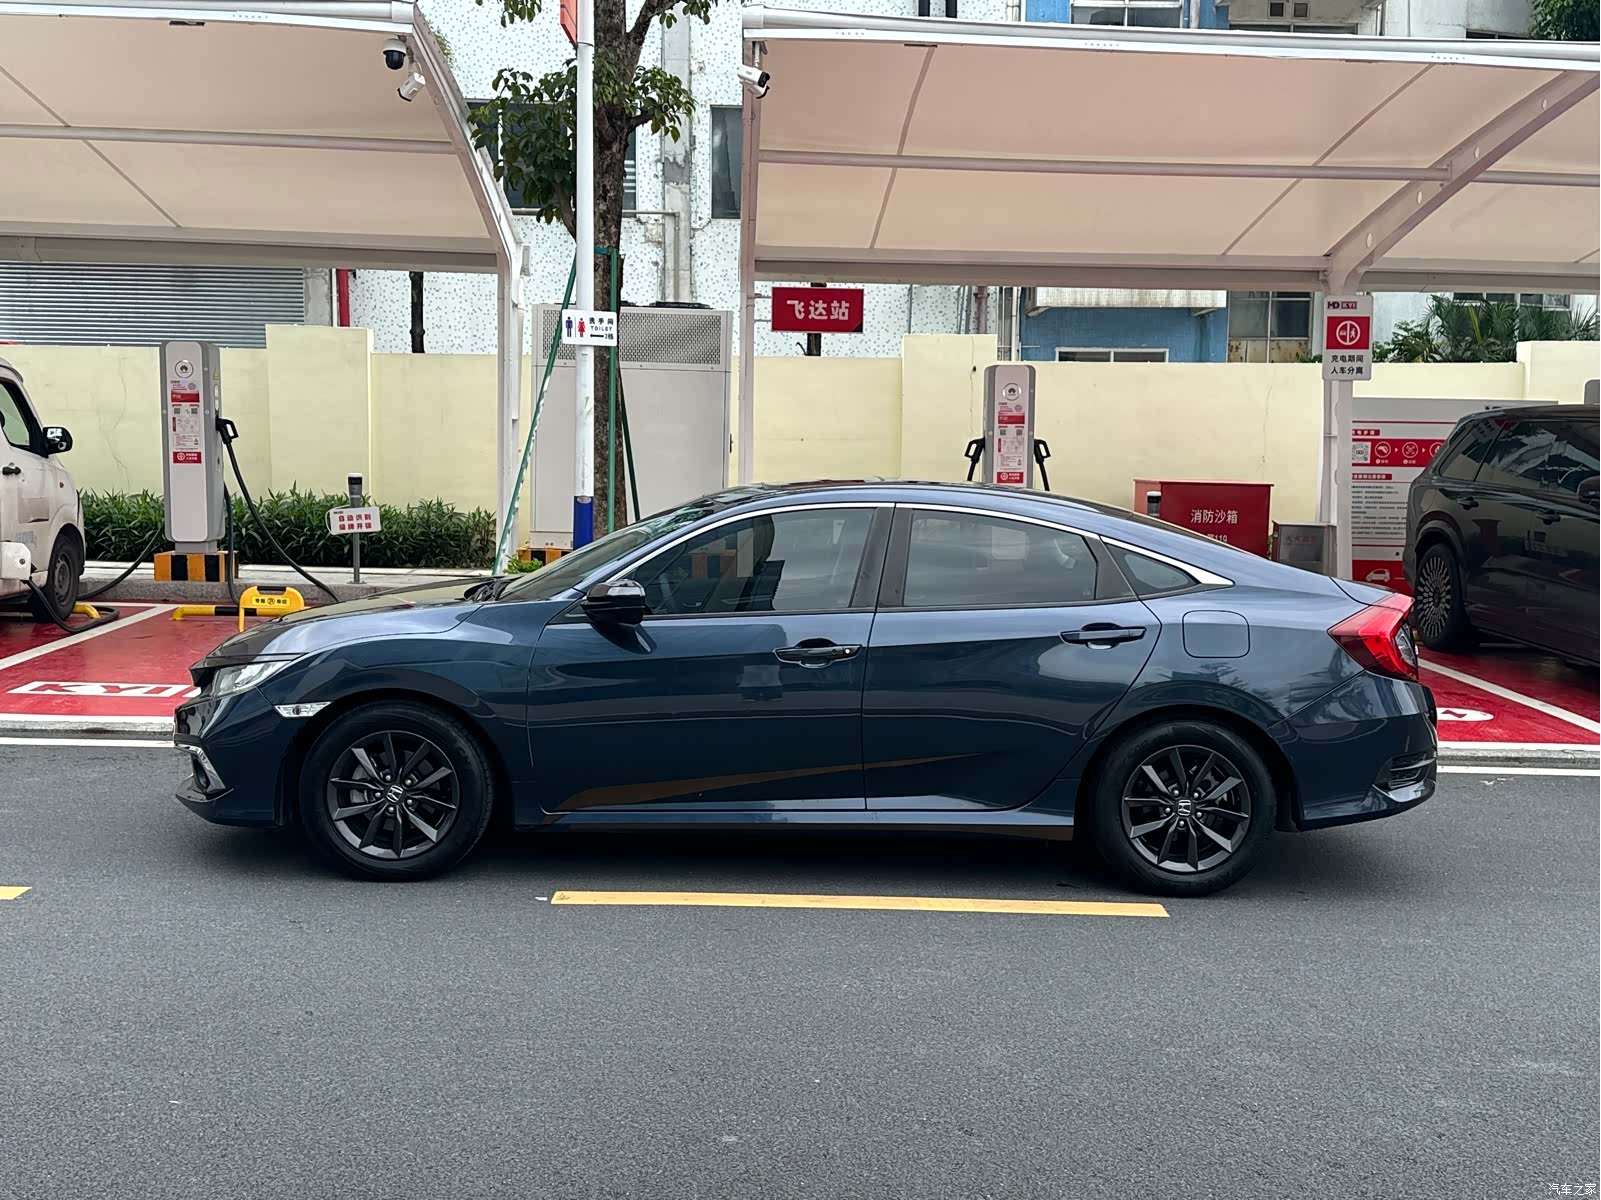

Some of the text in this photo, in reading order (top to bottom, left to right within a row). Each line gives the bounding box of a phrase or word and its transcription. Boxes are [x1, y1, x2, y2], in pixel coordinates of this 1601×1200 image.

[786, 299, 850, 321] 飞达站
[1327, 301, 1340, 310] MD
[588, 316, 614, 326] 洗手间
[1330, 354, 1364, 363] 充电期间
[1330, 366, 1364, 375] 人车分离
[1190, 509, 1238, 524] 消防沙箱
